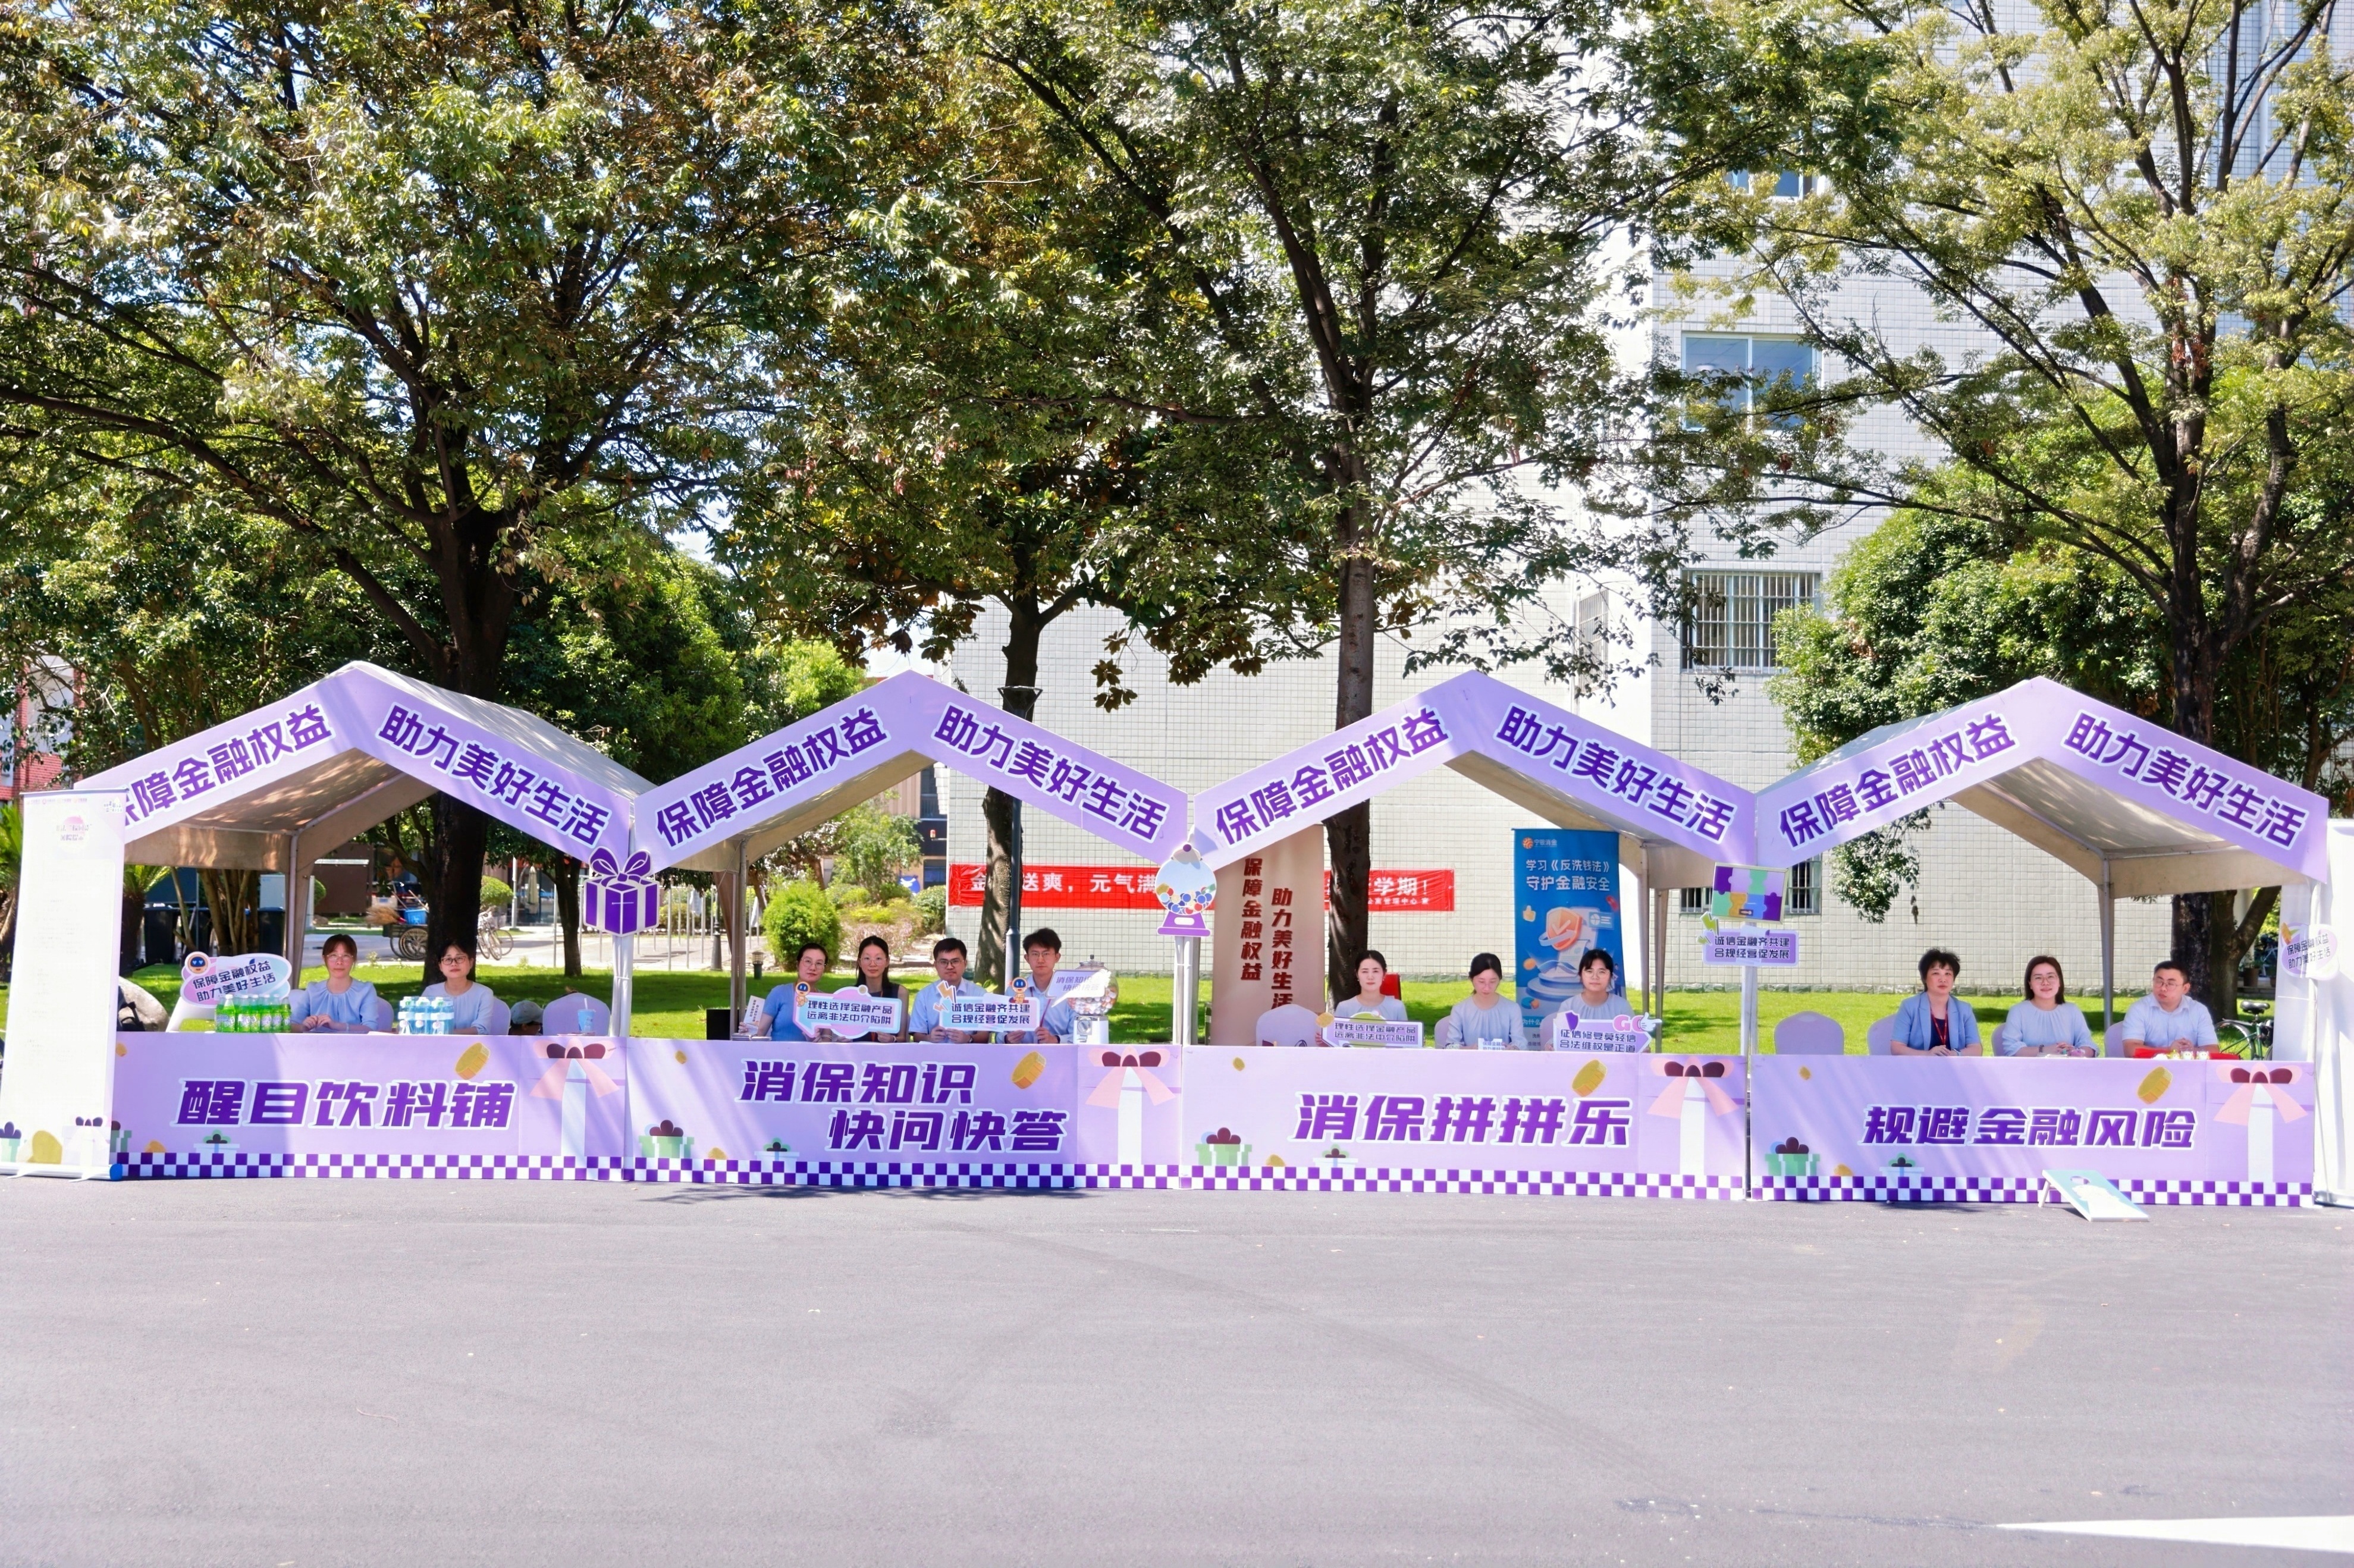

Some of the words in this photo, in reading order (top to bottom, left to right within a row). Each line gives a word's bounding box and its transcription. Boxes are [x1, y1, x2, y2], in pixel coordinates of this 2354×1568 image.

[378, 705, 610, 845] 助力美好生活
[657, 707, 887, 847] 保障金融权益
[934, 705, 1167, 841] 助力美好生活
[1216, 708, 1449, 845] 保障金融权益
[1496, 706, 1735, 842] 助力美好生活
[1779, 715, 2015, 847] 保障金融权益
[2064, 714, 2306, 847] 助力美好生活
[1526, 859, 1609, 872] 学习《反洗钱法》
[1526, 875, 1610, 891] 守护金融安全
[1241, 858, 1263, 981] 保障金融权益
[1271, 888, 1293, 1010] 助力美好生活
[1715, 936, 1790, 947] 诚信金融齐共建
[1715, 948, 1790, 959] 合规经营促发展
[2287, 934, 2329, 956] 保障金融权益
[2288, 947, 2331, 969] 助力美好生活
[193, 960, 271, 989] 保障金融权益
[196, 972, 276, 1002] 助力美好生活
[807, 1010, 891, 1025] 远离非法中介陷阱
[808, 1000, 892, 1014] 理性选择金融产品
[952, 1003, 1030, 1013] 诚信金融齐共建
[952, 1014, 1030, 1024] 合规经营促发展
[1334, 1022, 1415, 1033] 理性选择金融产品
[1334, 1031, 1415, 1042] 远离非法中介陷阱
[1560, 1029, 1636, 1042] 征信修复莫轻信
[1559, 1039, 1636, 1053] 合法维权是正道
[739, 1060, 976, 1104] 消保知识
[176, 1080, 515, 1127] 醒目饮料铺
[828, 1109, 1067, 1152] 快问快答
[1294, 1093, 1631, 1146] 消保拼拼乐
[1862, 1106, 2196, 1148] 规避金融风险
